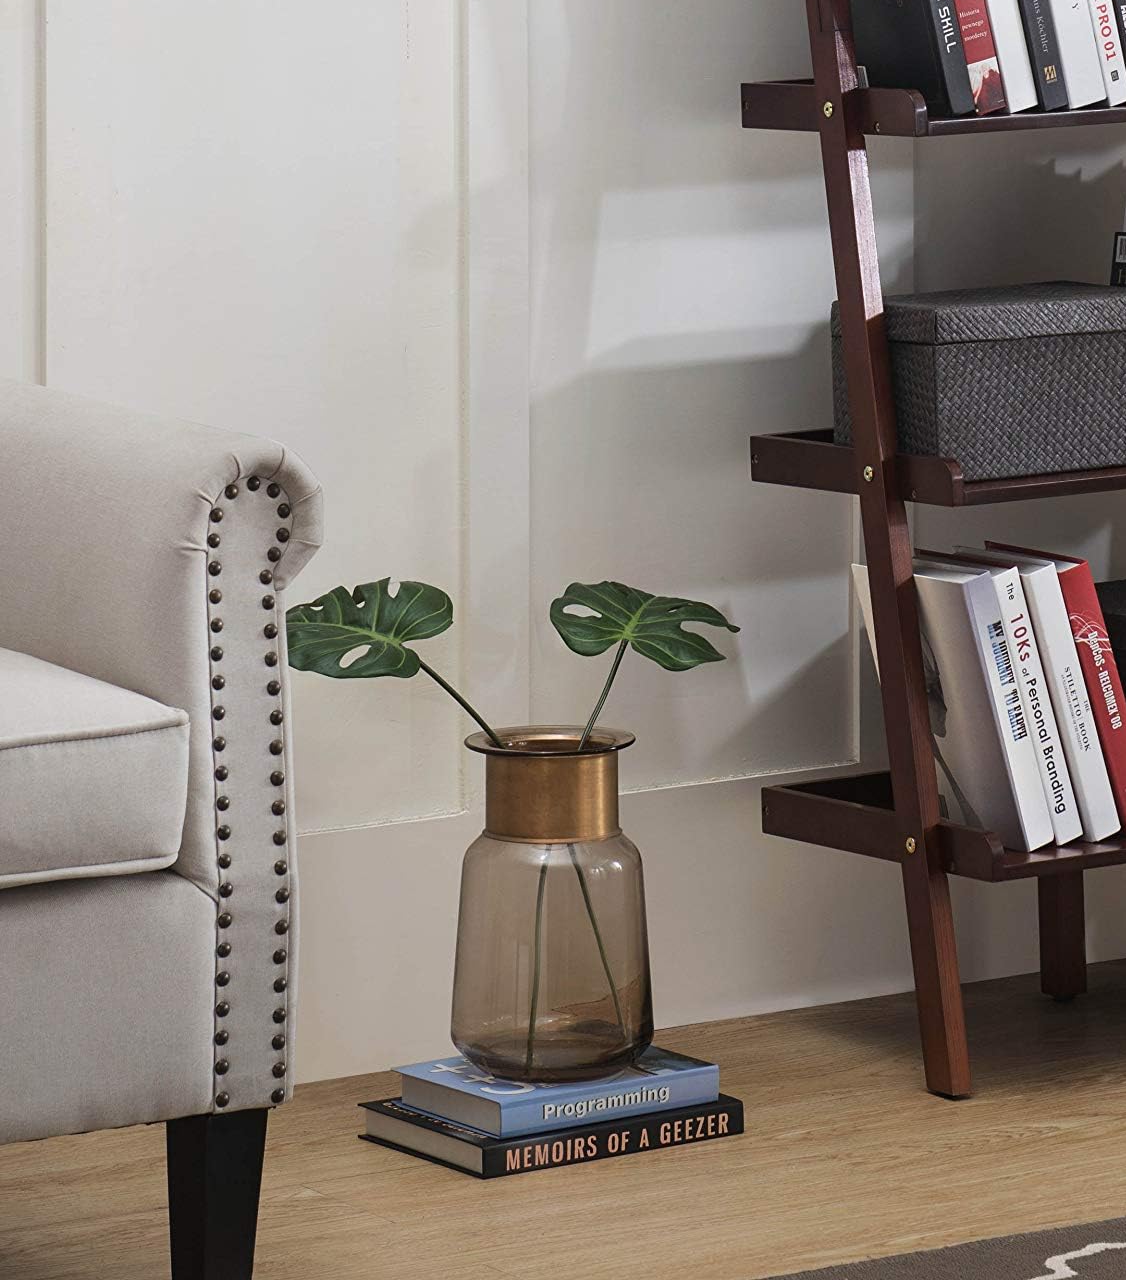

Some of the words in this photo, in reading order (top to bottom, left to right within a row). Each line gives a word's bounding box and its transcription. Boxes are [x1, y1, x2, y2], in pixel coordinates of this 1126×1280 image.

[938, 6, 956, 53] SKILL
[1097, 4, 1111, 37] PRO
[1104, 41, 1117, 61] 01
[992, 640, 1015, 686] JOURNEY
[1008, 704, 1027, 741] EARTH
[1006, 582, 1014, 600] The
[1010, 613, 1031, 662] 10Ks
[1022, 667, 1030, 677] of
[1026, 677, 1051, 743] Personal
[1043, 745, 1066, 815] Branding
[1064, 666, 1082, 717] STILETTO
[1078, 722, 1092, 752] BOOK
[1098, 670, 1118, 715] RELCOMEX
[542, 1084, 671, 1121] Programming
[506, 1134, 598, 1172] MEMOIRS
[607, 1128, 630, 1154] OF
[639, 1127, 650, 1148] A
[659, 1112, 730, 1145] GEEZER
